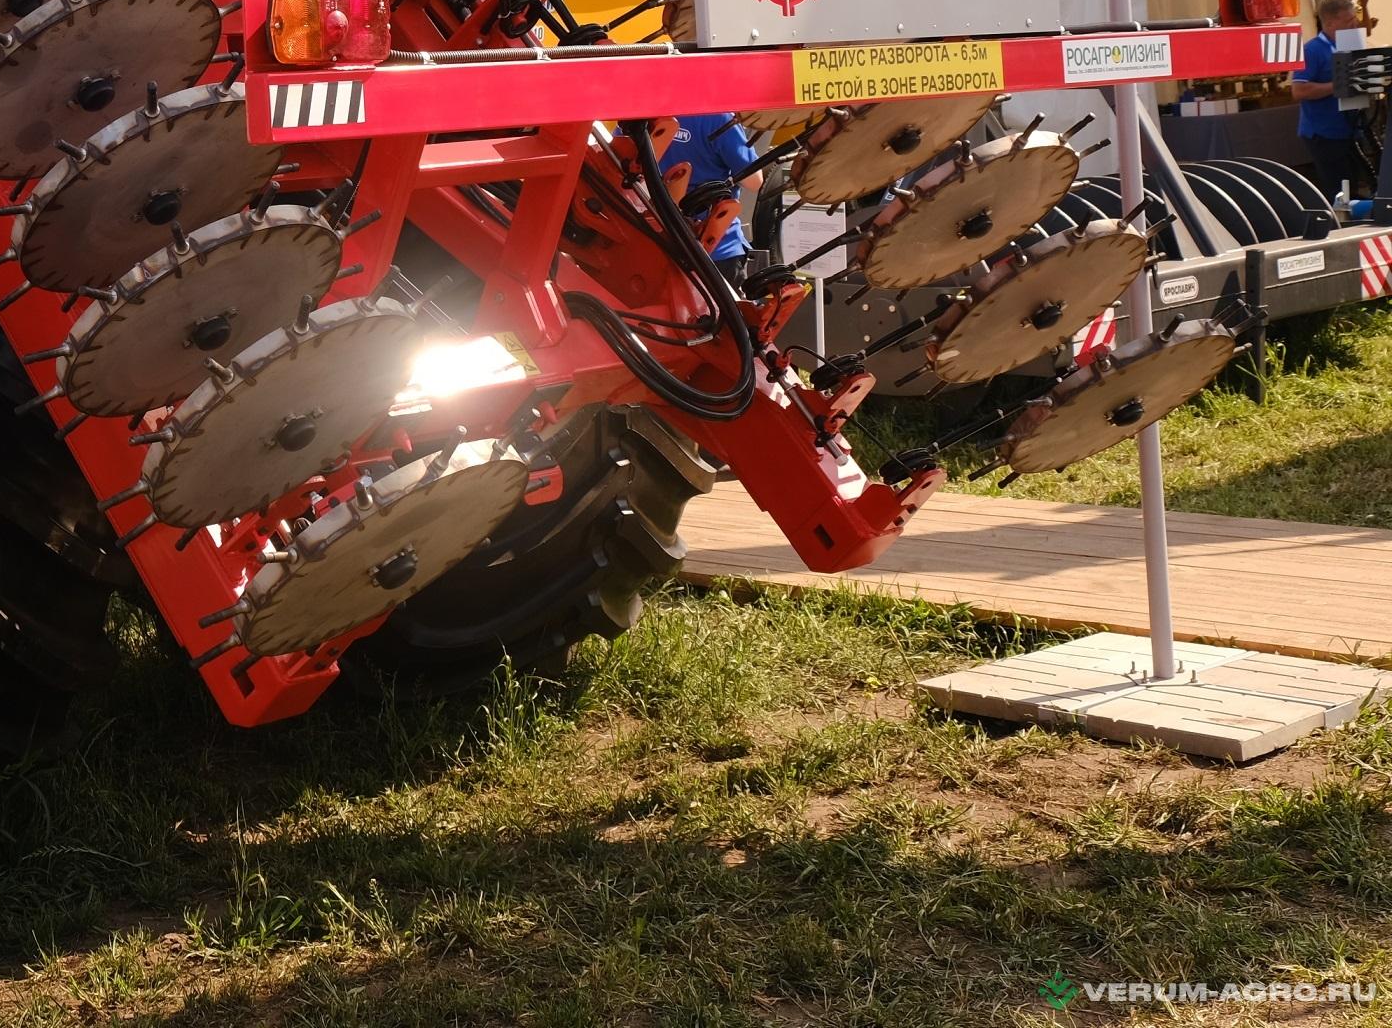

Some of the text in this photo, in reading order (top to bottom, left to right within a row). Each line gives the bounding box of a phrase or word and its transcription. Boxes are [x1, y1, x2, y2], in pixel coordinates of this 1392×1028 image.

[809, 49, 866, 71] РАДИУС
[870, 45, 950, 66] РАЗВОРОТА
[960, 43, 988, 64] 6,5м
[1066, 42, 1167, 67] РОСАГРОЛИЗИНГ
[801, 71, 998, 102] НЕ СТОЙ В ЗОНЕ РАЗВОРОТА
[1163, 282, 1196, 297] ЯРОСЛАВИЧ
